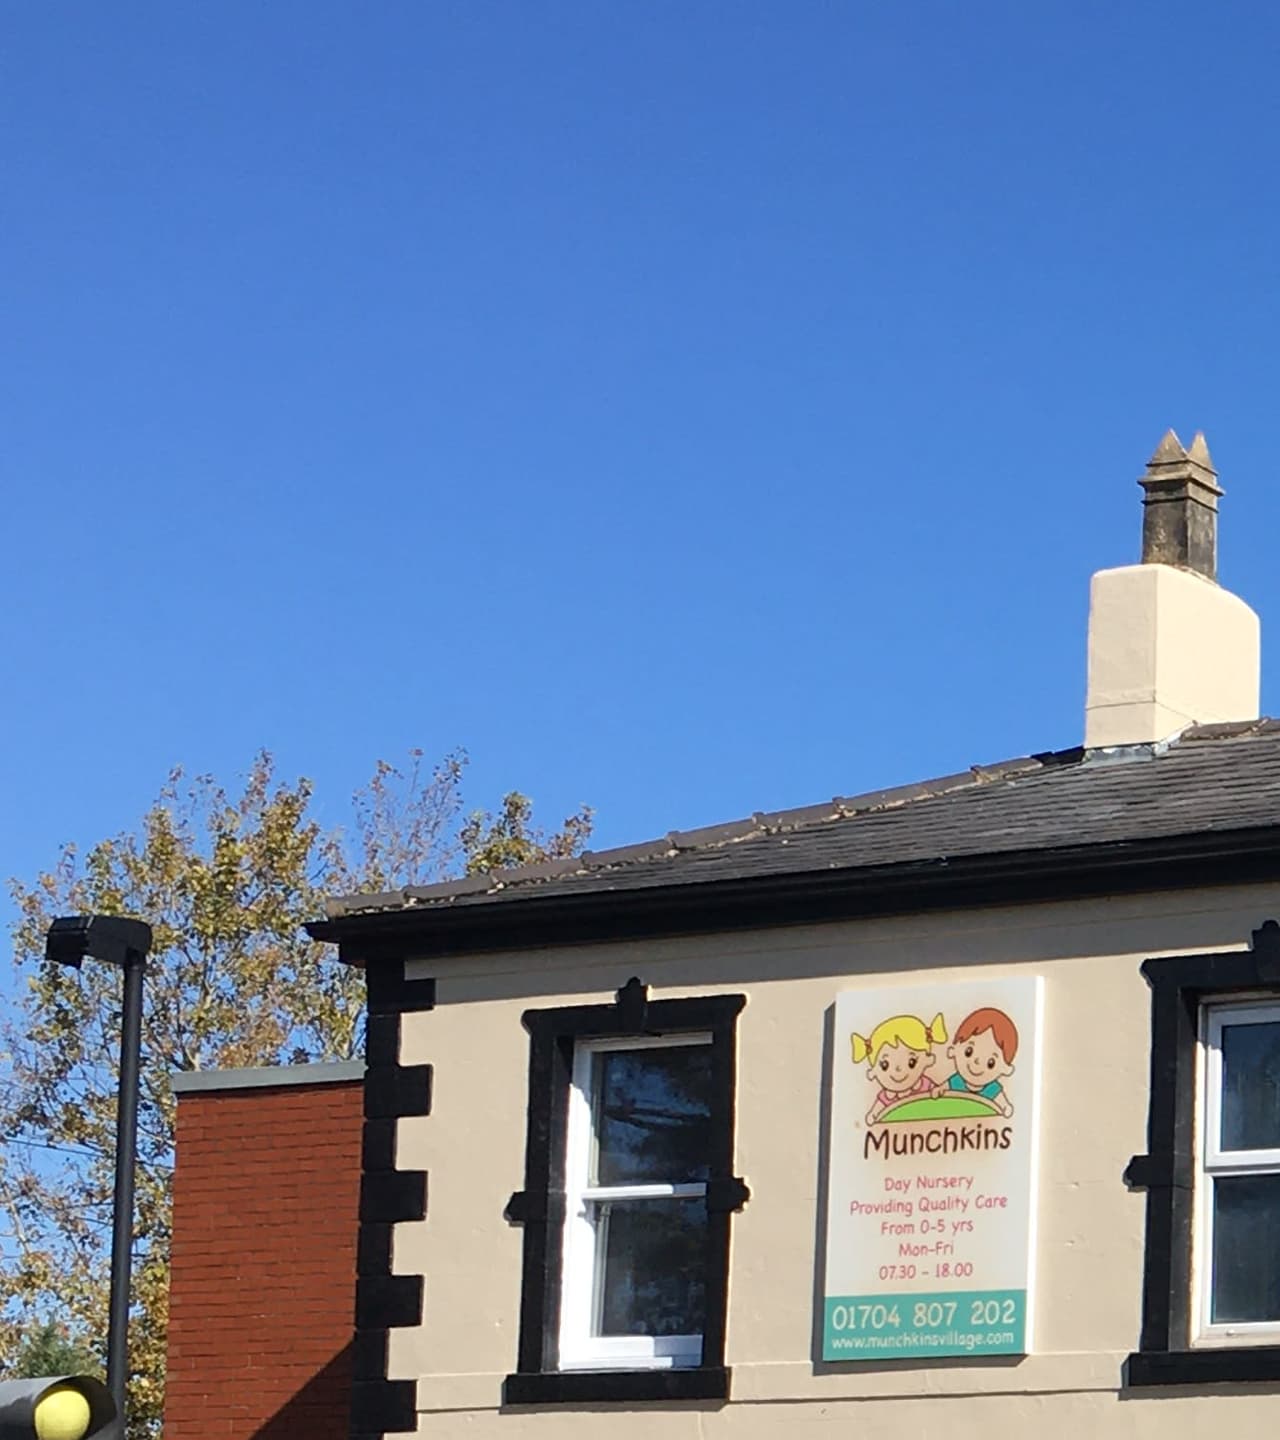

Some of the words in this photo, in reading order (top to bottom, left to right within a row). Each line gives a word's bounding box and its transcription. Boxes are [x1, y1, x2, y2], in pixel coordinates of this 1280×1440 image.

[864, 1123, 1013, 1160] Munchkins
[884, 1177, 911, 1193] Day
[917, 1176, 974, 1190] Nursery
[850, 1200, 913, 1217] Providing
[919, 1196, 969, 1213] Quality
[975, 1194, 1008, 1209] Care
[881, 1221, 915, 1236] From
[920, 1219, 946, 1234] 0-5
[952, 1219, 974, 1236] yrs
[899, 1241, 954, 1257] Mon-Fri
[879, 1264, 917, 1280] 07.30
[936, 1262, 973, 1278] 18.00
[832, 1304, 901, 1330] 01704
[913, 1302, 957, 1327] 807
[970, 1299, 1016, 1325] 202
[832, 1331, 1014, 1350] www.munchkinsvillage.com
